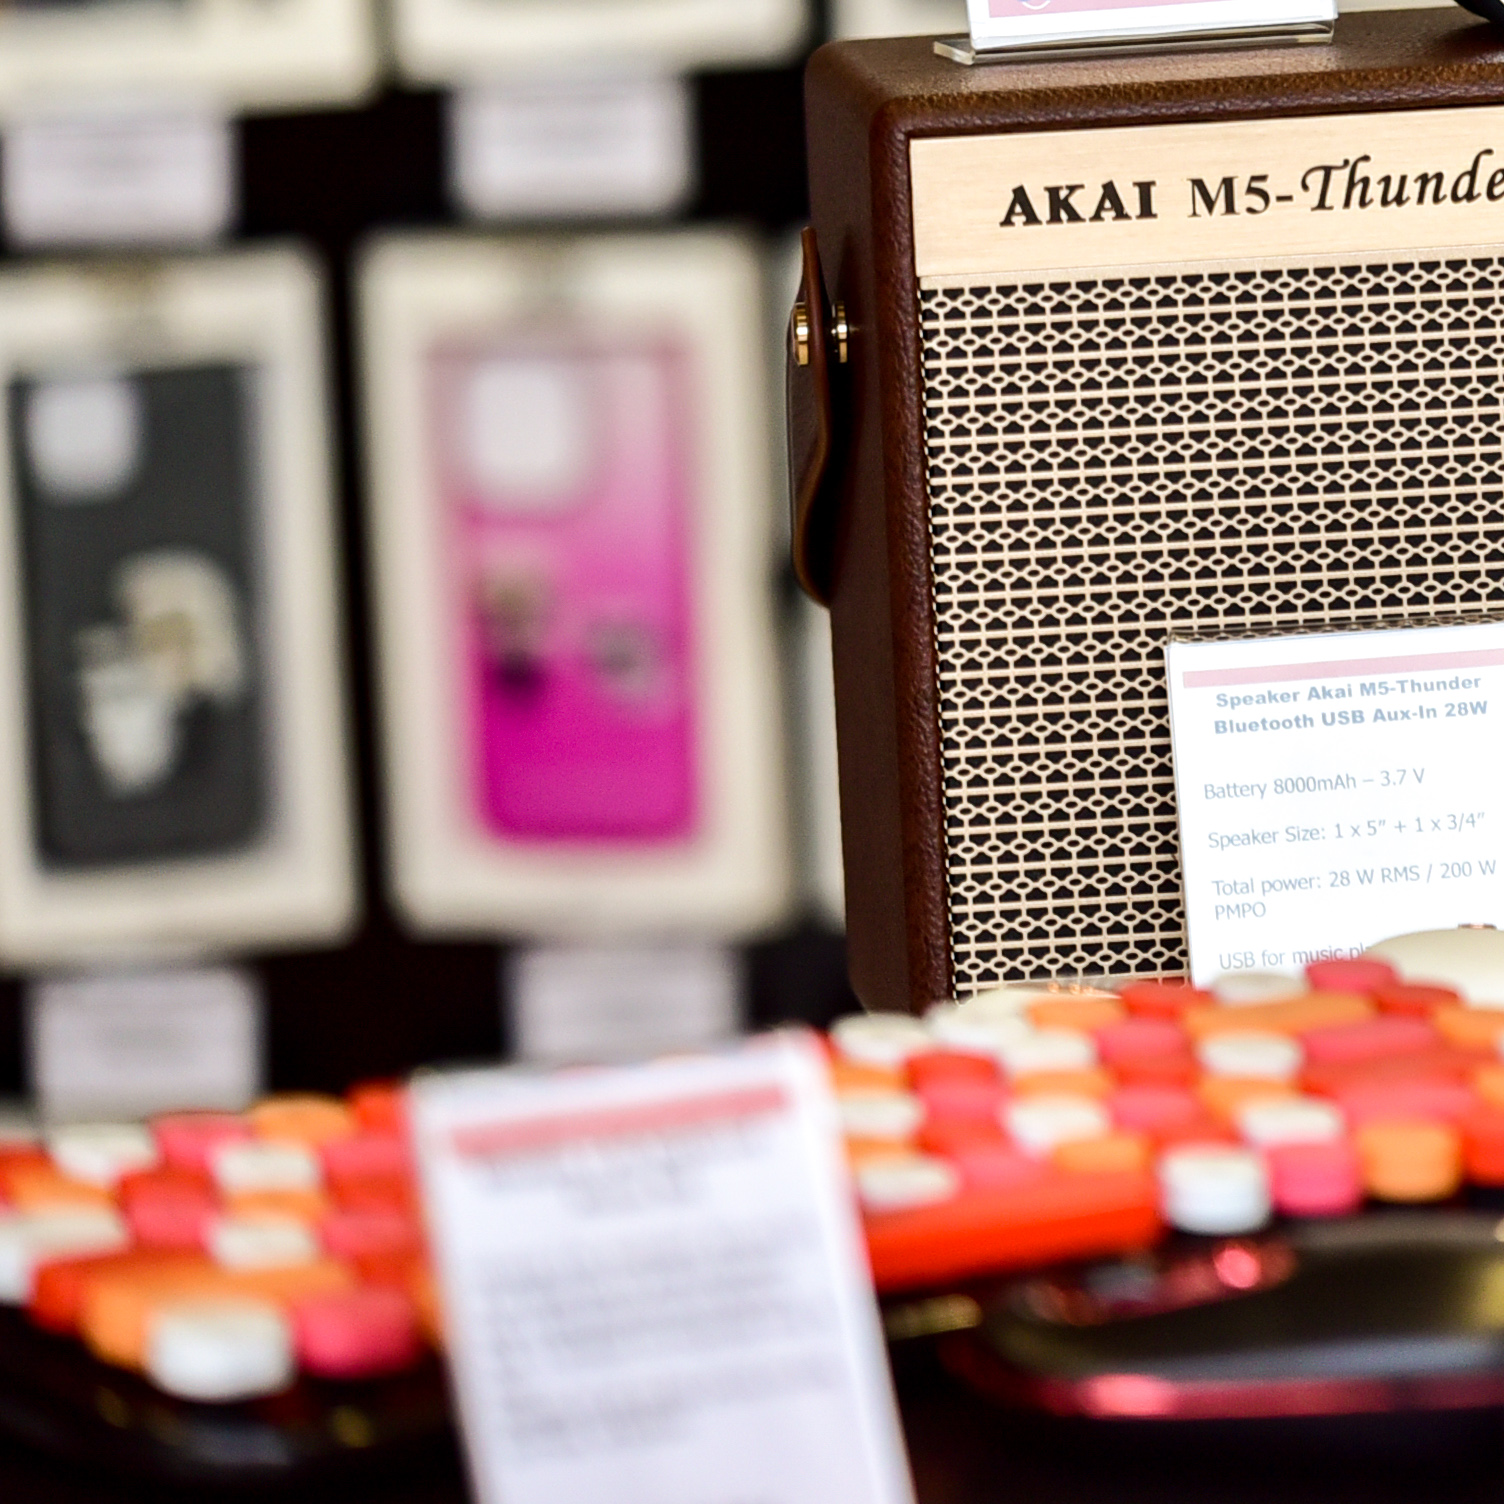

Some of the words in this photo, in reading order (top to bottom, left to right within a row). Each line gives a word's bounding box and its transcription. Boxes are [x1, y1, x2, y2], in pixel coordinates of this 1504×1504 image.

[999, 180, 1158, 228] AKAI
[1216, 689, 1301, 710] Speaker
[1307, 683, 1353, 701] Akai
[1359, 676, 1482, 697] M5-Thunder
[1214, 714, 1315, 734] Bluetooth
[1321, 709, 1365, 727] USB
[1372, 704, 1437, 723] Aux-In
[1444, 700, 1488, 718] 28W
[1203, 782, 1268, 800] Battery
[1273, 772, 1357, 795] 8000mAh
[1380, 769, 1407, 787] 3.7
[1412, 768, 1425, 784] V
[1208, 829, 1279, 851] Speaker
[1284, 825, 1327, 843] Size:
[1335, 823, 1343, 839] 1
[1350, 824, 1361, 837] x
[1394, 820, 1407, 834] +
[1415, 817, 1424, 832] 1
[1430, 818, 1442, 831] x
[1211, 878, 1255, 896] Total
[1261, 875, 1322, 896] power:
[1329, 870, 1351, 888] 28
[1356, 868, 1375, 885] W
[1381, 865, 1420, 884] RMS
[1426, 863, 1433, 883] /
[1440, 861, 1472, 879] 200
[1478, 859, 1497, 876] W
[1214, 901, 1267, 921] PMPO
[1219, 951, 1256, 970] USB
[1262, 949, 1285, 967] for
[1292, 945, 1343, 964] music
[1349, 942, 1371, 962] pl
